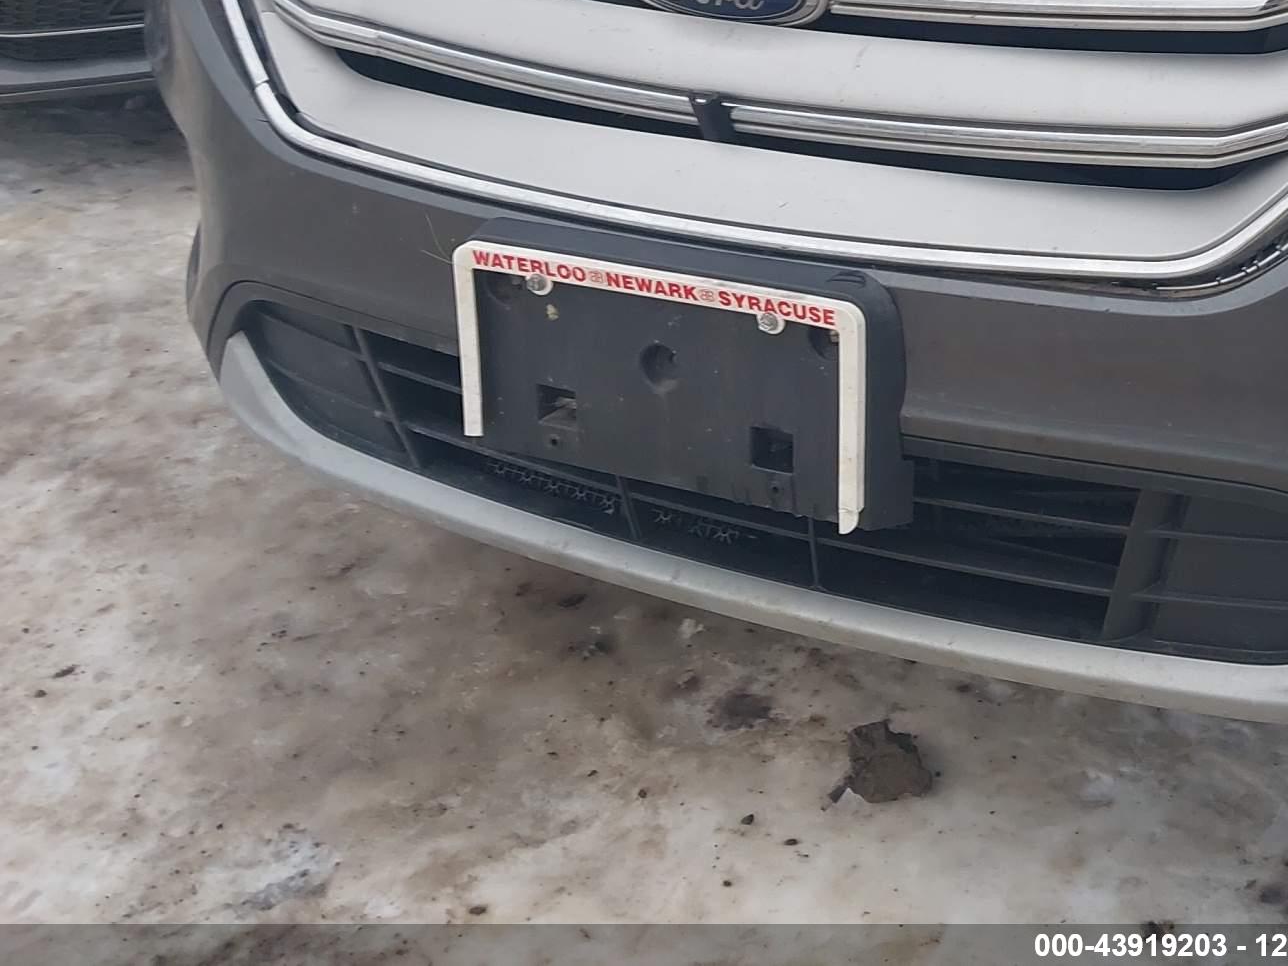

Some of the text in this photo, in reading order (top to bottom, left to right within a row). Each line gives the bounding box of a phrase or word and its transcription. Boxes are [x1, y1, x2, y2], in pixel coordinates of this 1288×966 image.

[473, 250, 836, 326] WATERLOO NEWARK SYRACUSE
